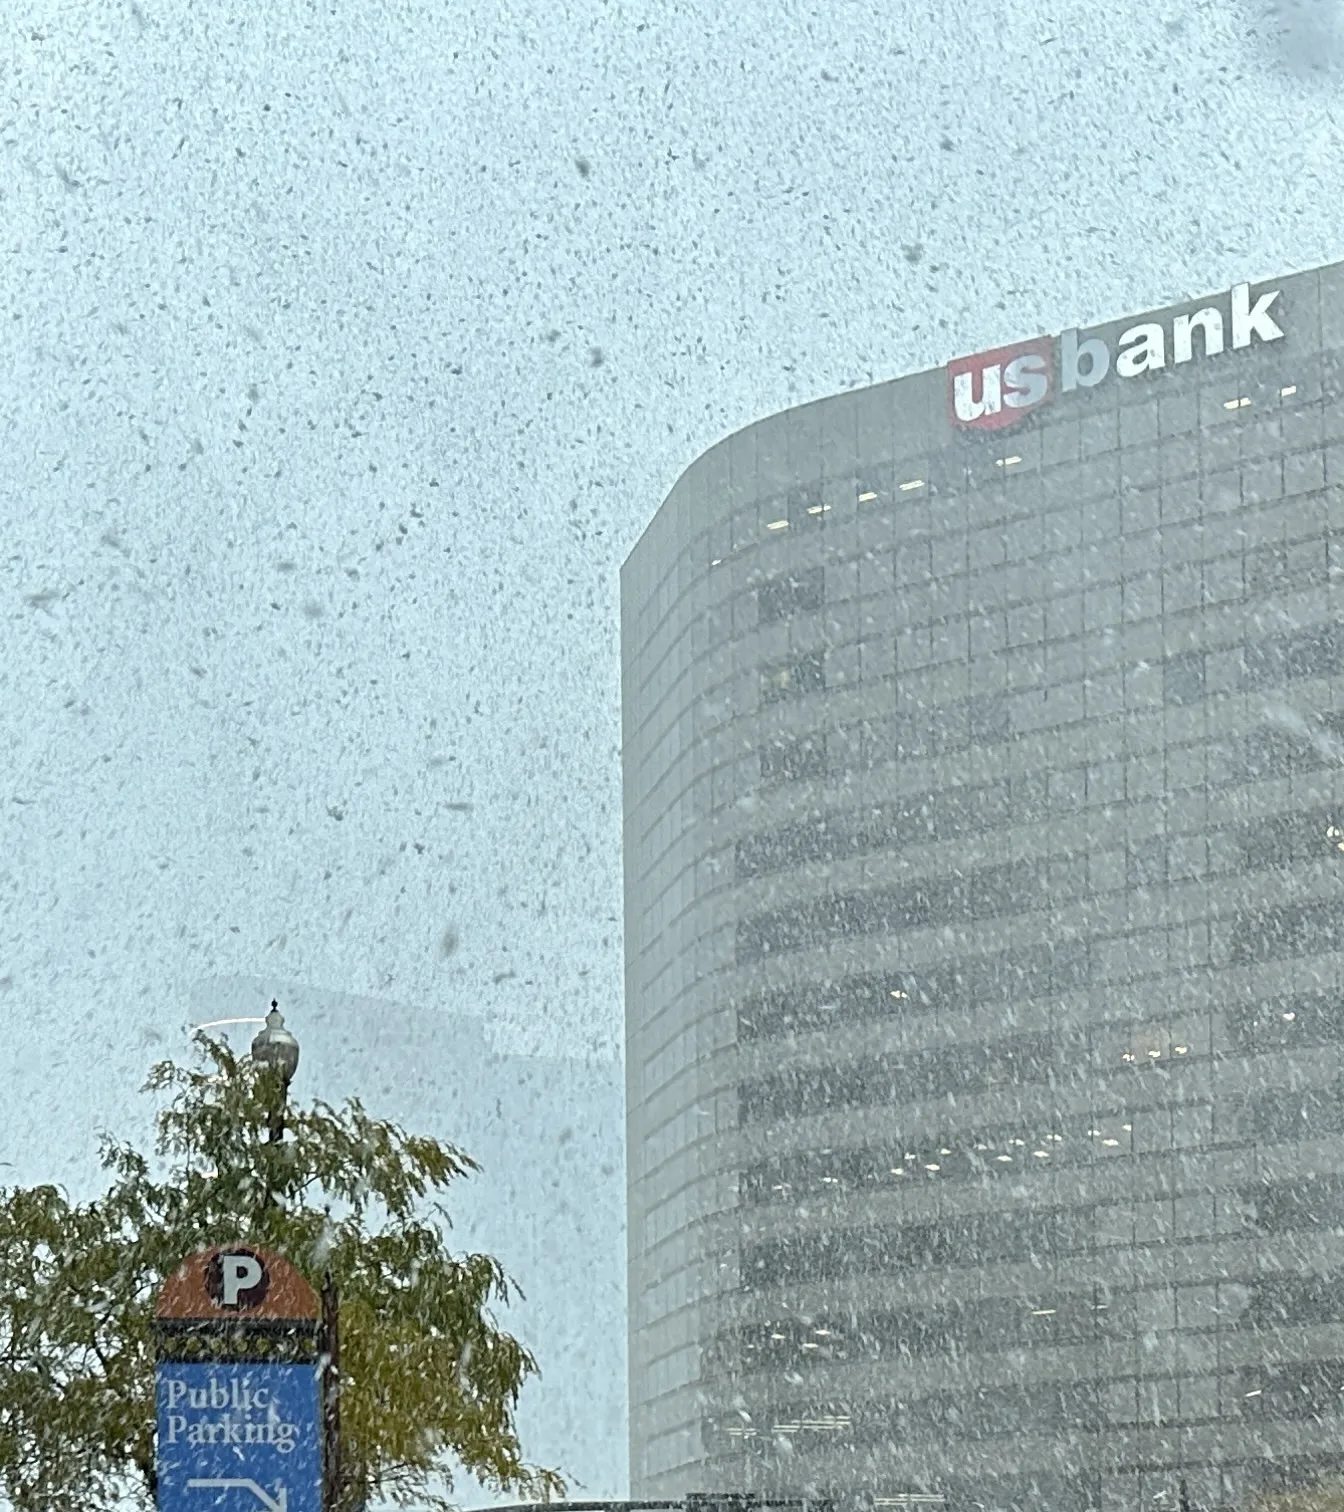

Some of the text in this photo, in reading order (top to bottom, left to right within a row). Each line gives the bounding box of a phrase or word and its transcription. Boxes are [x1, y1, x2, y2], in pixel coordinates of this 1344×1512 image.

[222, 1255, 263, 1305] P
[166, 1378, 270, 1410] Public
[166, 1413, 297, 1453] Parking
